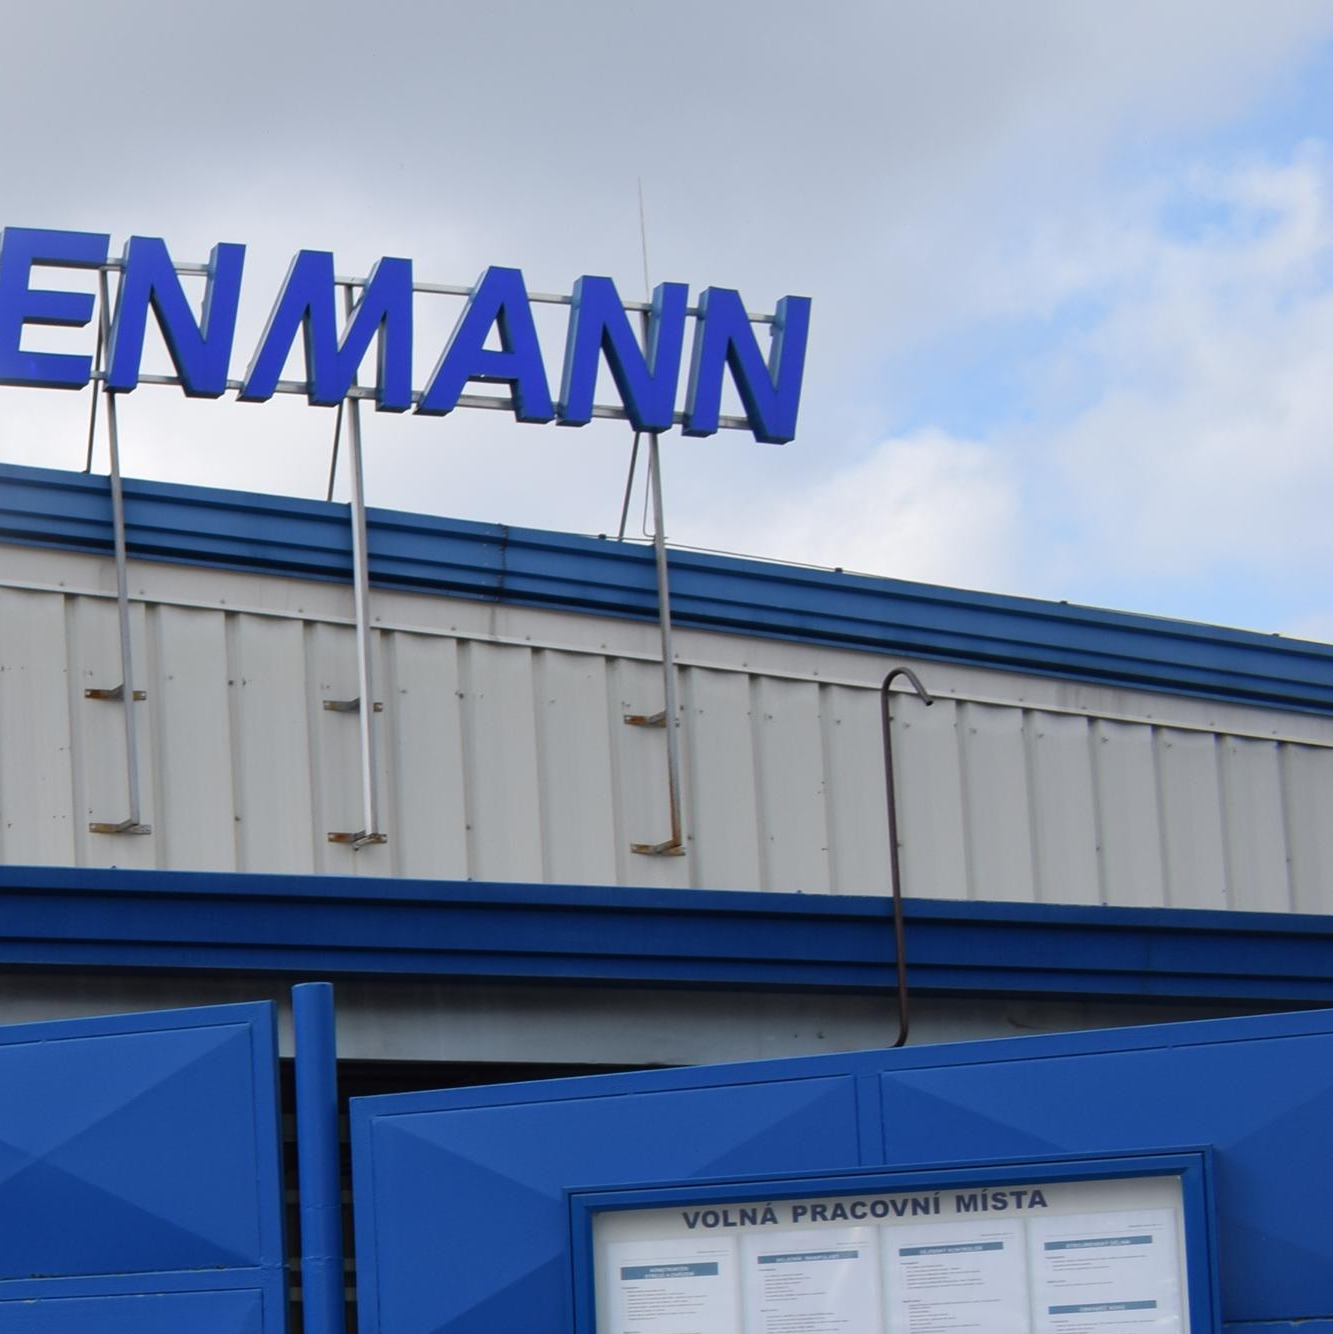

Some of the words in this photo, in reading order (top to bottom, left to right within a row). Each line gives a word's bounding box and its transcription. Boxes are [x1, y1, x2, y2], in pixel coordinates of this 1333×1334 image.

[682, 1200, 778, 1230] VOLNÁ
[790, 1191, 941, 1224] PRACOVNÍ
[954, 1186, 1049, 1212] MÍSTA
